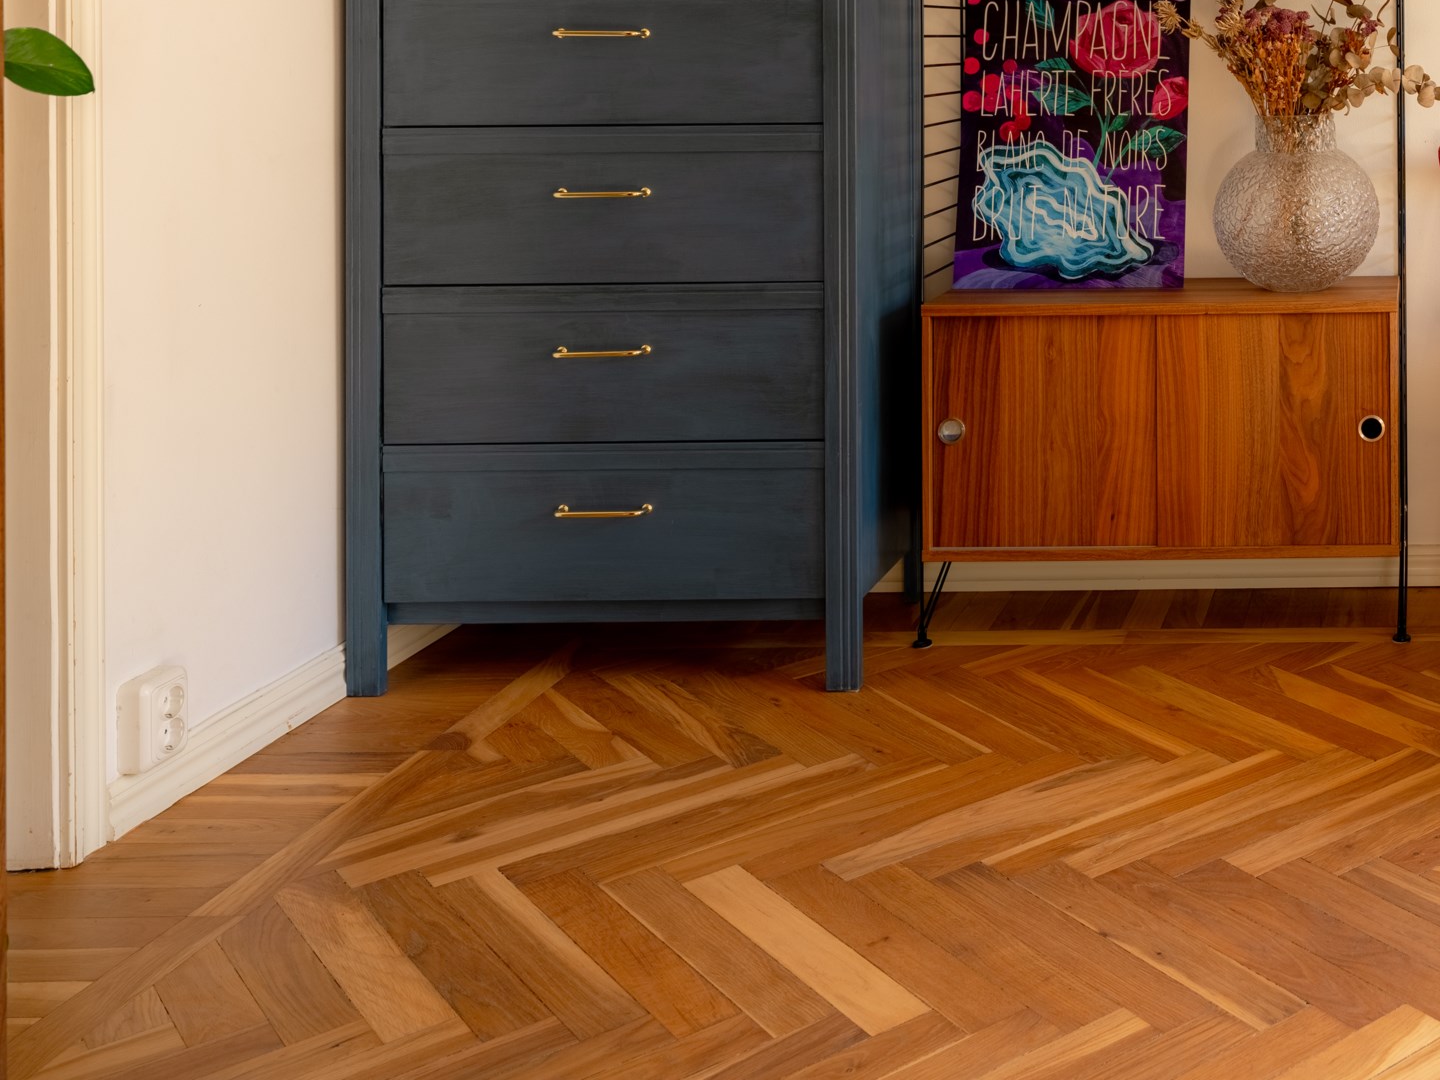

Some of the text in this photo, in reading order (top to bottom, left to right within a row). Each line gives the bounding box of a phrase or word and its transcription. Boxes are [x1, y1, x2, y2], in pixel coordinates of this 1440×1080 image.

[980, 63, 1172, 117] LAHERTE FRÈRES
[976, 128, 1168, 172] BLANC DE NOIRS
[972, 184, 1167, 241] BRUT NATURE
